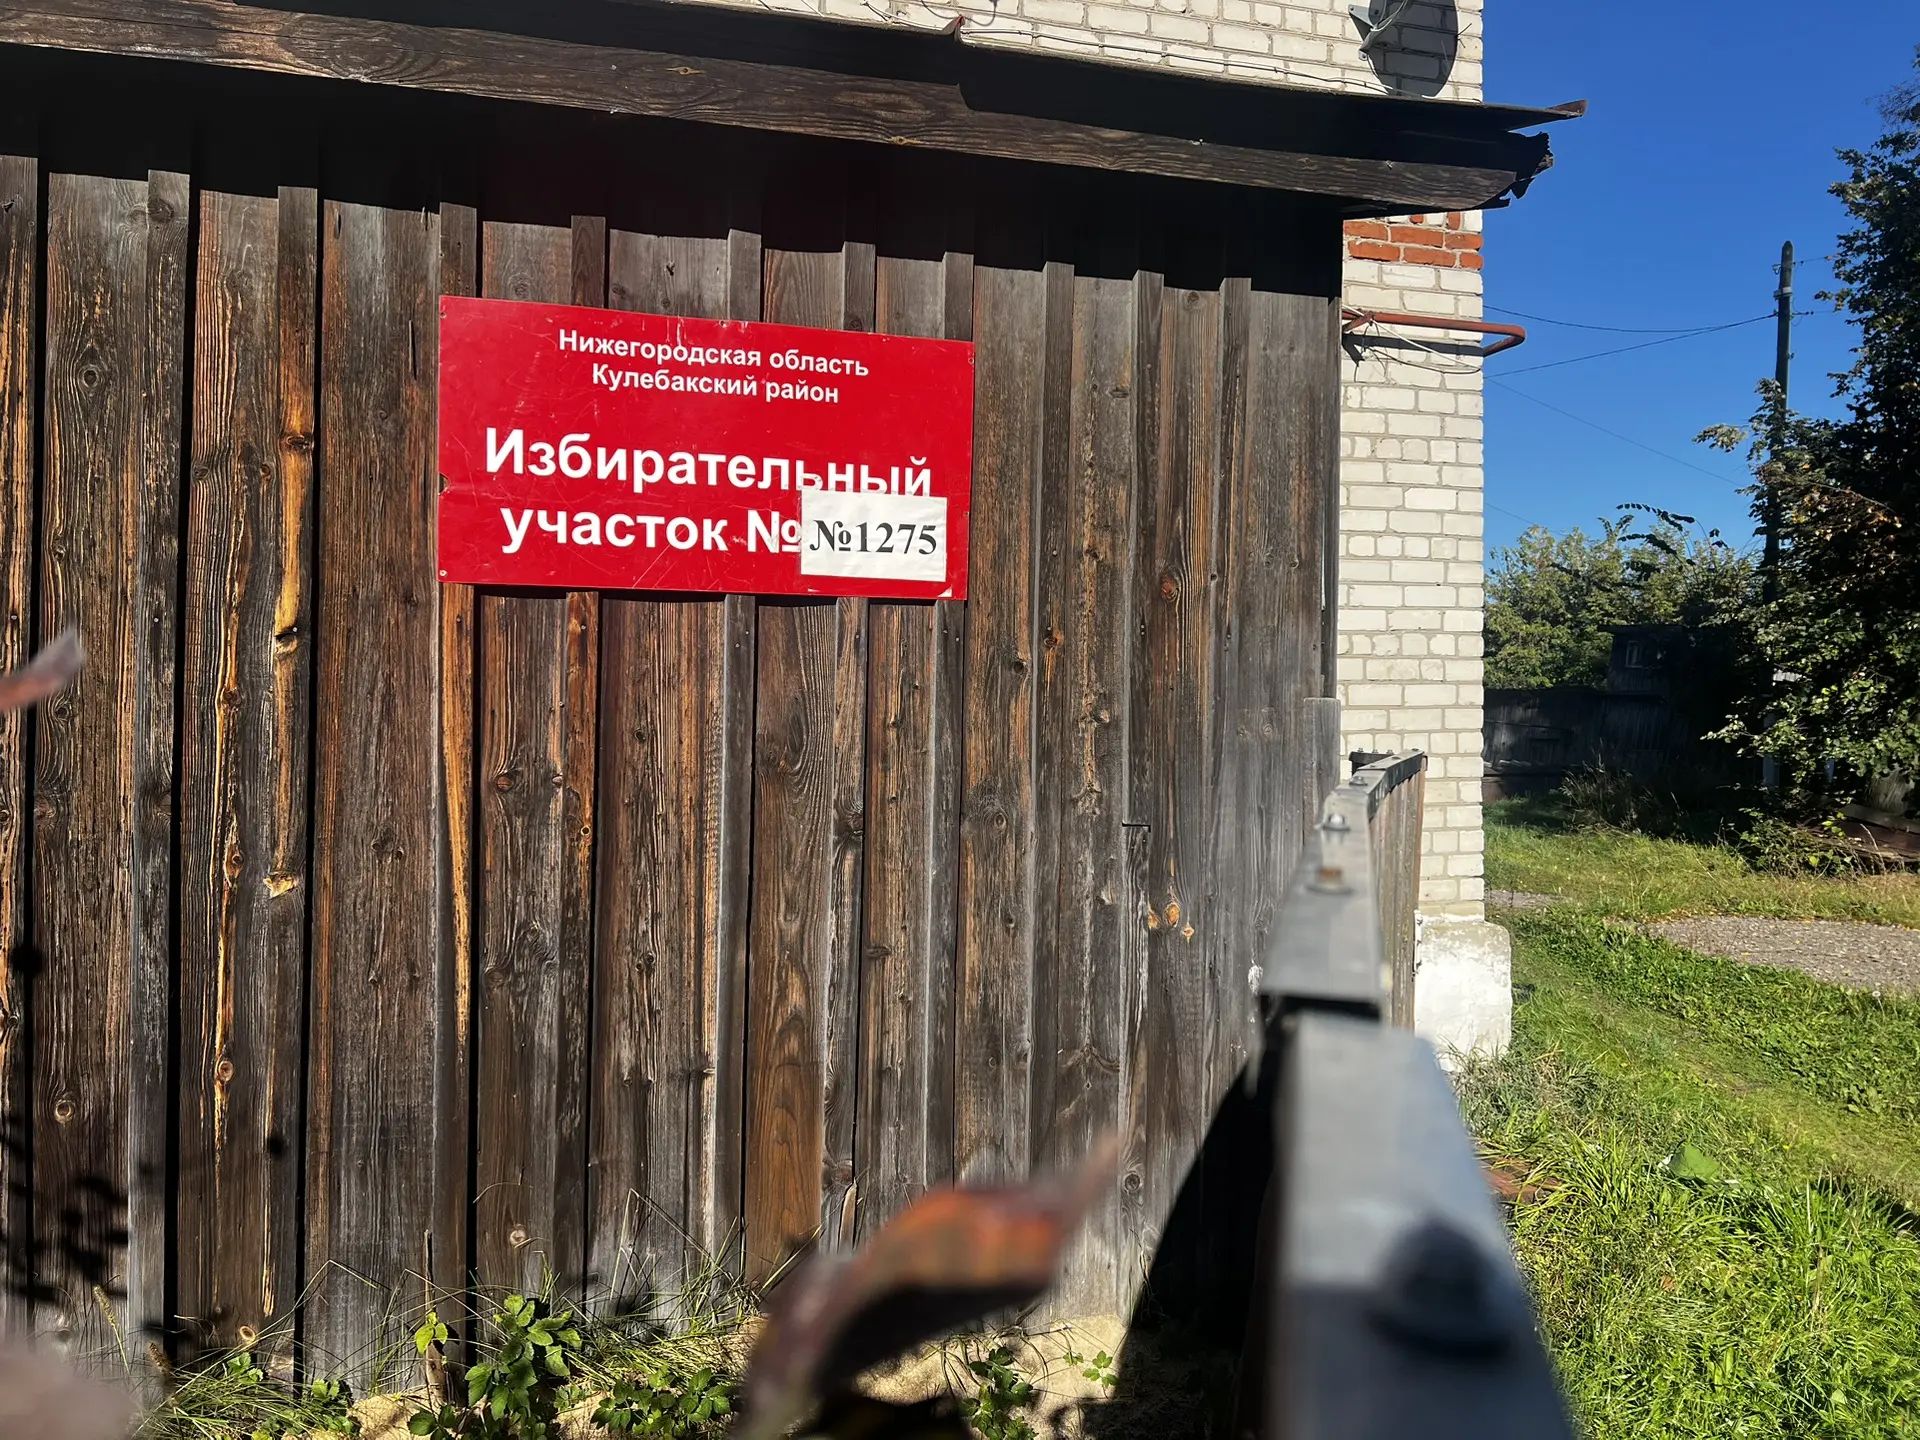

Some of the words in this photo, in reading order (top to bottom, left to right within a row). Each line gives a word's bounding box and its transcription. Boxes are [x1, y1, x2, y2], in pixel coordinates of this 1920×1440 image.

[559, 328, 761, 367] Нижегородская
[769, 350, 869, 375] область
[591, 363, 758, 397] Кулебакский
[765, 379, 839, 404] район
[485, 427, 932, 497] Избирательный
[501, 507, 728, 554] участок
[809, 519, 938, 555] №1275
